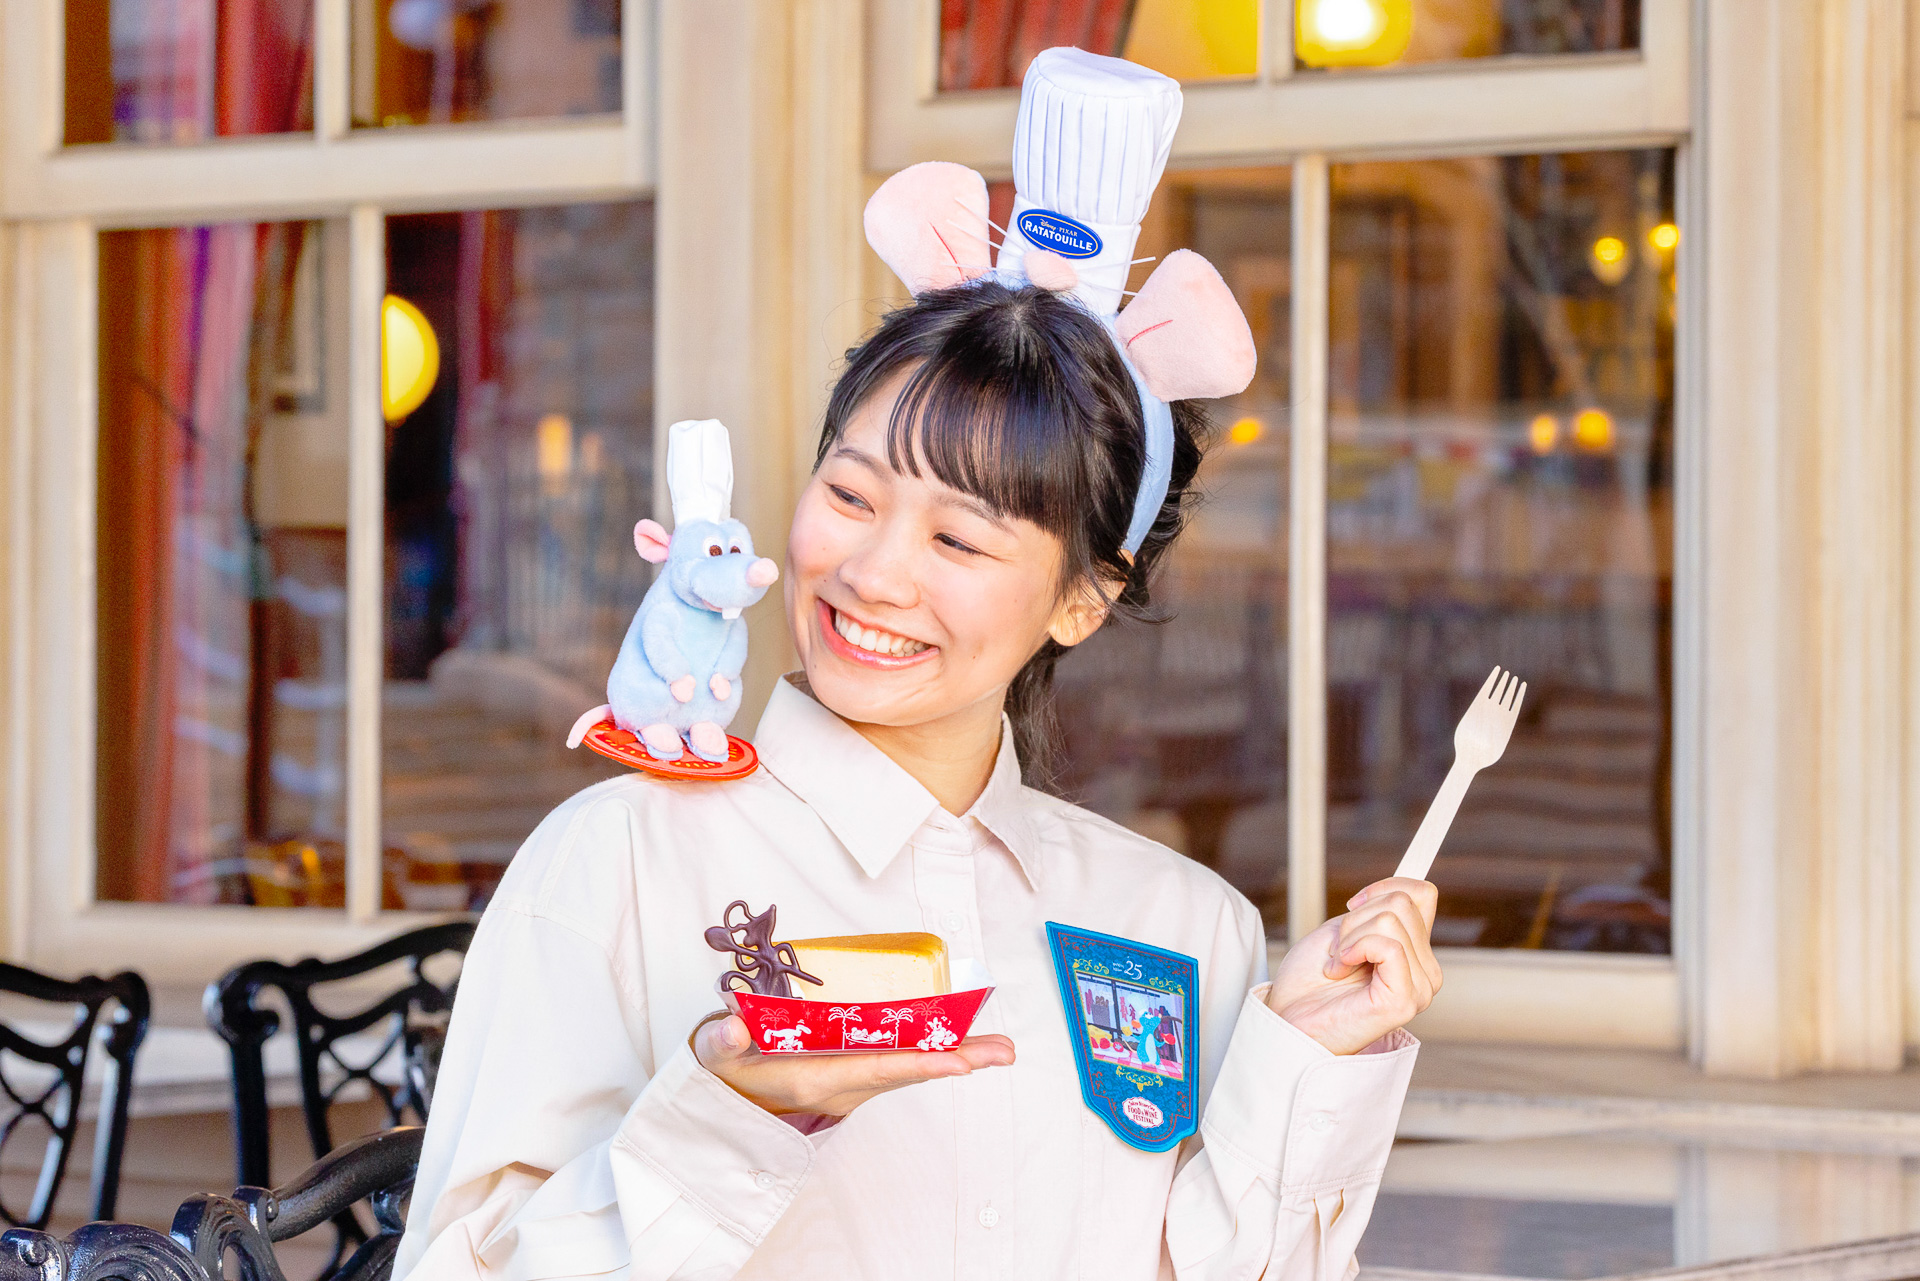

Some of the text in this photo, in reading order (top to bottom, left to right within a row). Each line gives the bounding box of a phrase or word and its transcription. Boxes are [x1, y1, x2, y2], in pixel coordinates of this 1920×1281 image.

[1025, 220, 1093, 251] RATATOUILLE
[1059, 227, 1078, 237] PIXAR
[1124, 960, 1142, 980] 25
